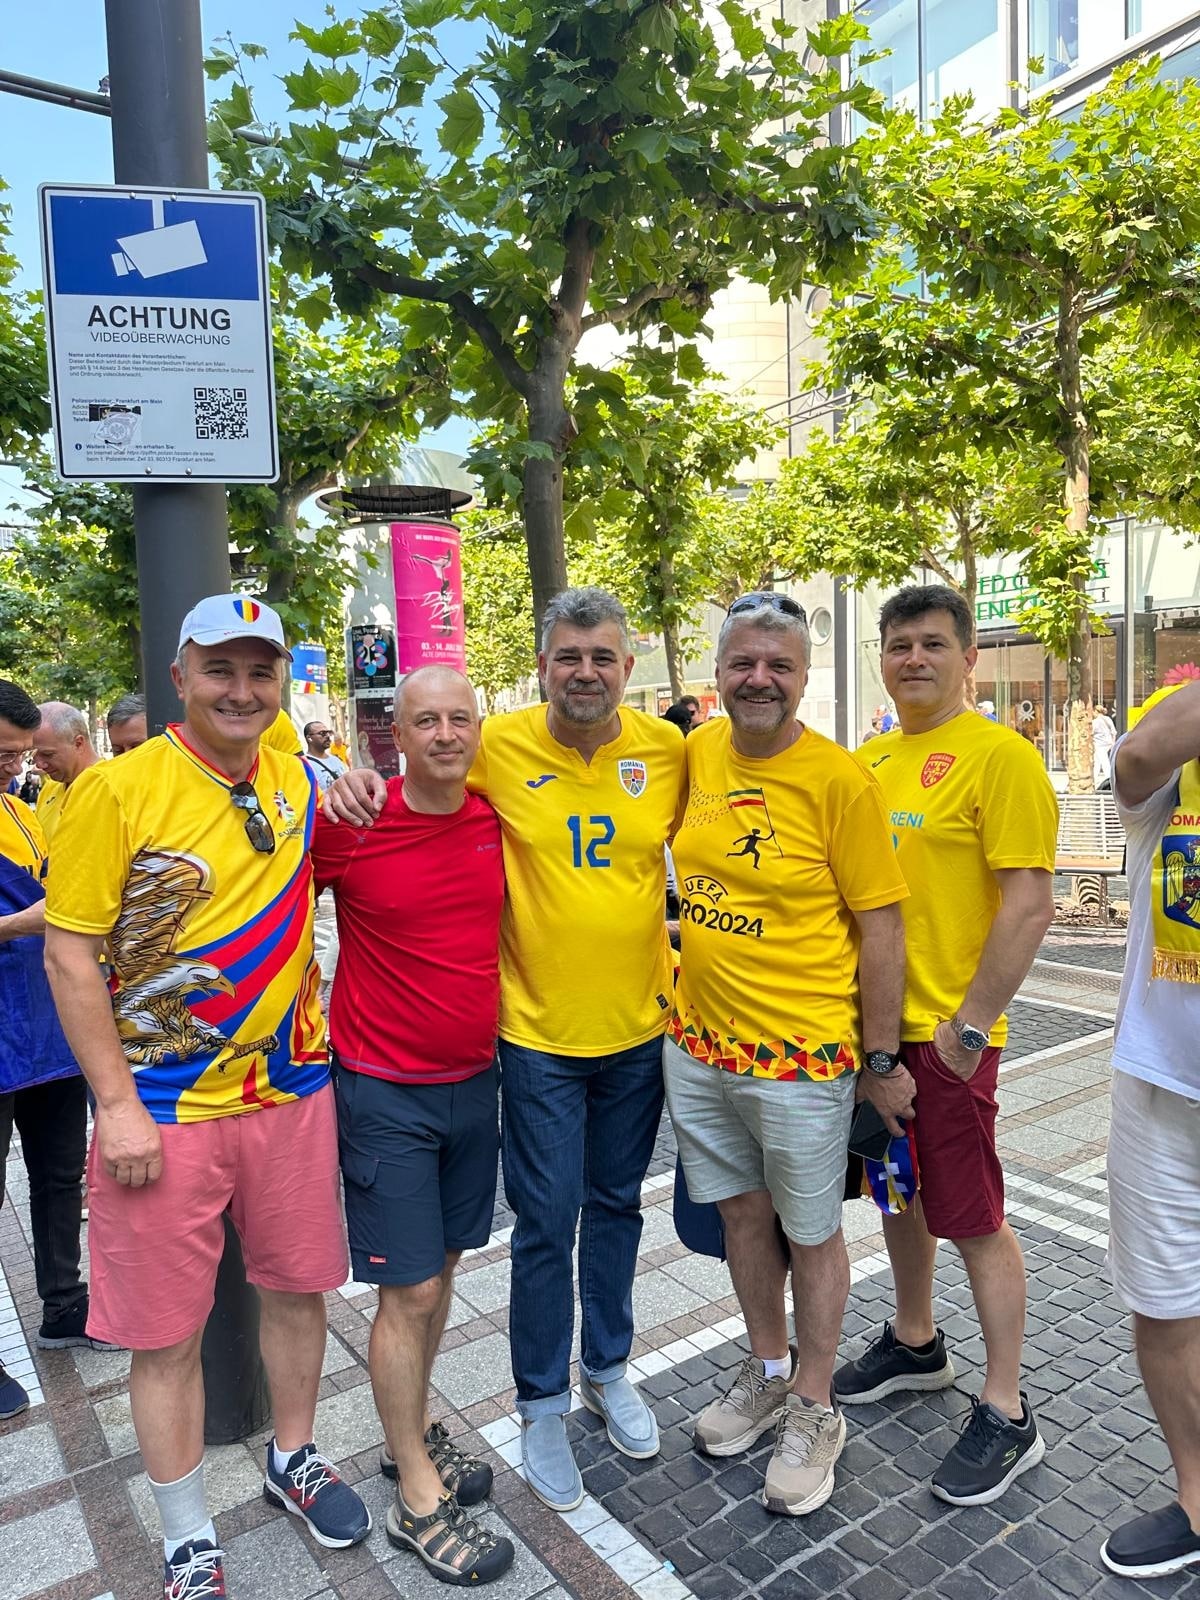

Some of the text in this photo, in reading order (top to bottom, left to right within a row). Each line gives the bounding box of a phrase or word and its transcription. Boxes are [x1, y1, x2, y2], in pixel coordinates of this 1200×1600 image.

[88, 304, 230, 330] ACHTUNG
[90, 331, 230, 345] VIDEOÜBERWACHUNG
[567, 816, 616, 868] 12
[686, 880, 723, 902] UEFA
[680, 896, 764, 938] RO2024
